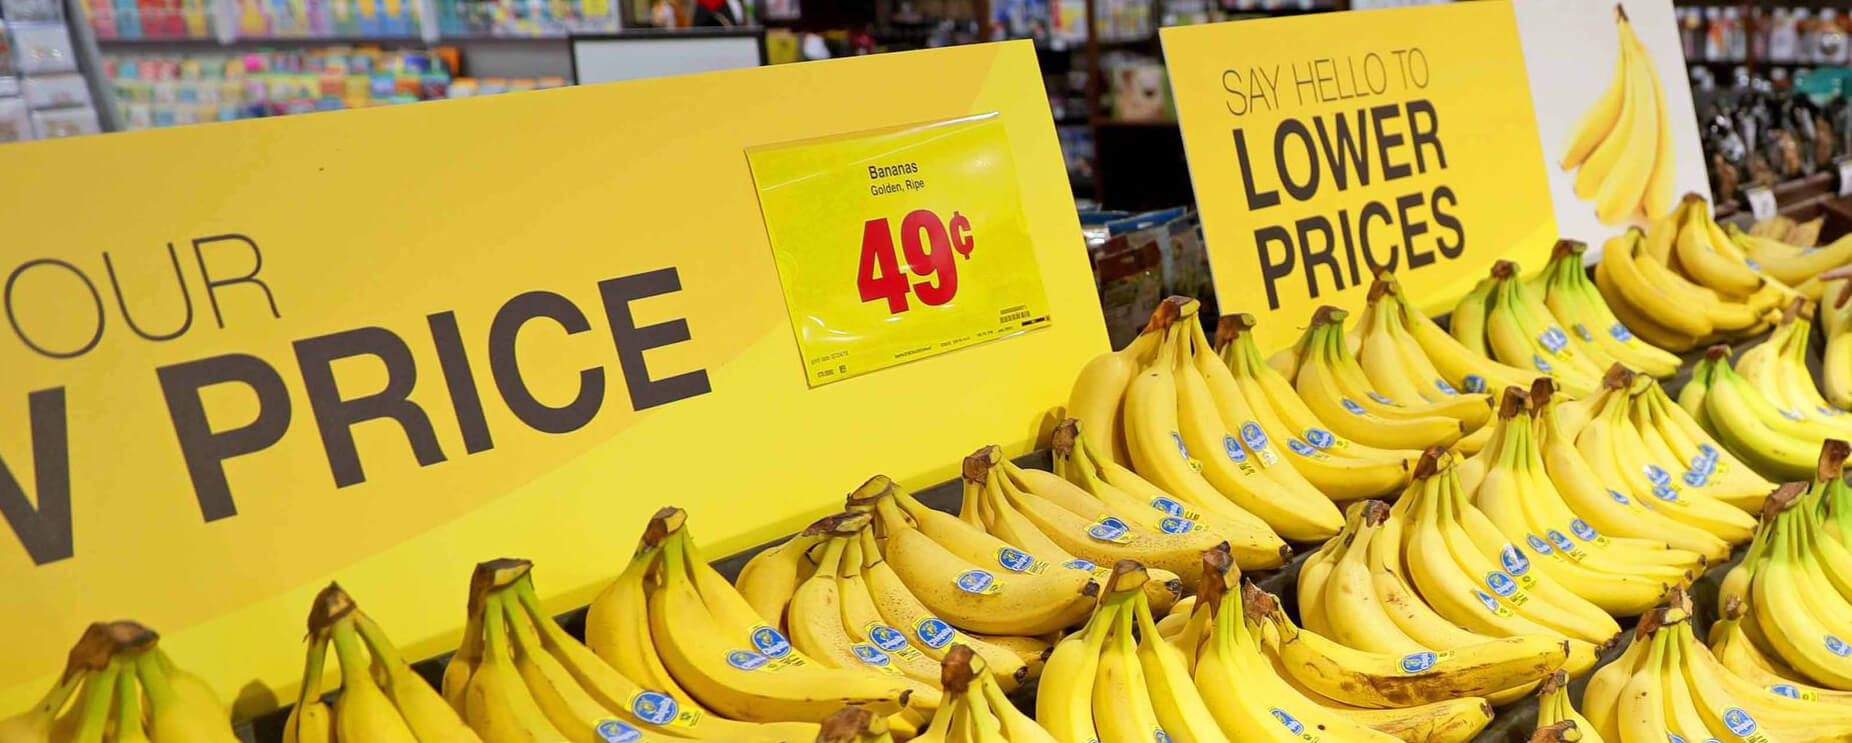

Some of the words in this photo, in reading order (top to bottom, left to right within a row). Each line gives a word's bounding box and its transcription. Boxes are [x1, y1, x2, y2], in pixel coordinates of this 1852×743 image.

[1222, 64, 1282, 117] SAY
[1292, 52, 1387, 106] HELLO
[1391, 47, 1430, 90] TO
[868, 160, 919, 180] Bananas
[871, 183, 905, 197] Golden,
[905, 178, 925, 193] Ripe
[1232, 99, 1448, 211] LOWER
[4, 233, 282, 360] OUR
[857, 208, 975, 315] 49¢
[1253, 185, 1466, 311] PRICES
[156, 266, 713, 523] PRICE
